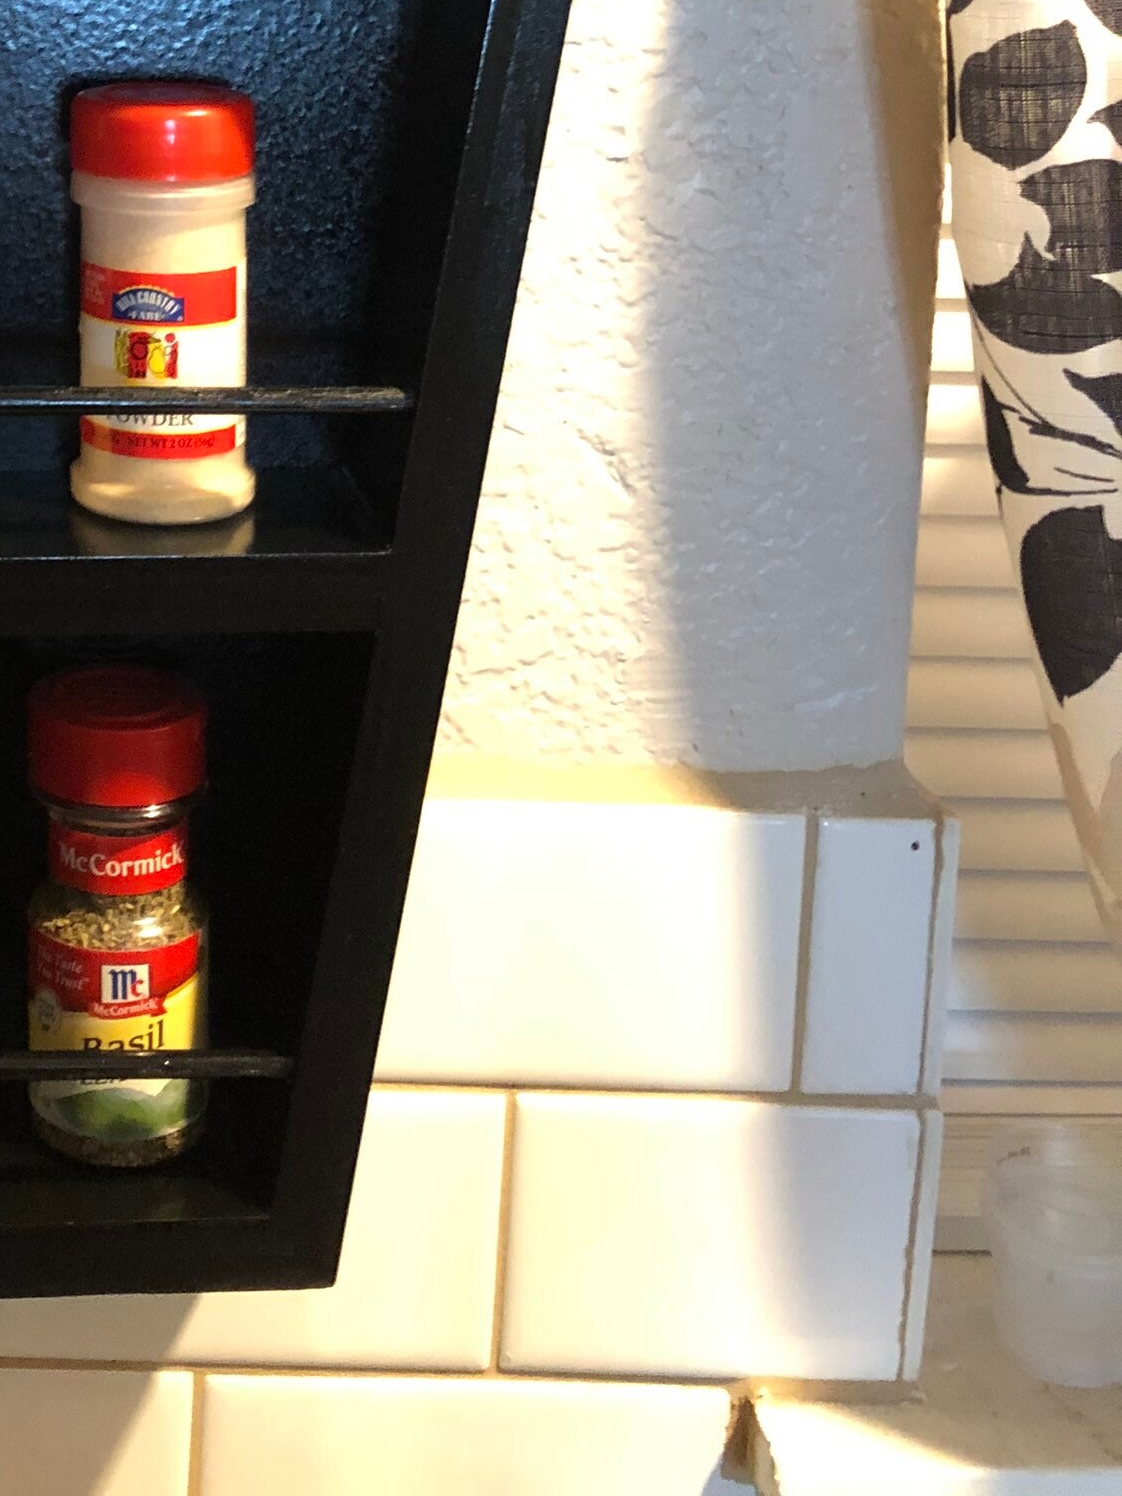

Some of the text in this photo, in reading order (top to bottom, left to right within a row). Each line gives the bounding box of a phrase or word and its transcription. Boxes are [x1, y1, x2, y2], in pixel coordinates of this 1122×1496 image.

[106, 415, 194, 426] OWDER
[170, 438, 176, 449] 2
[178, 437, 193, 448] OZ
[59, 841, 184, 877] McCormick
[93, 998, 159, 1017] McCormick
